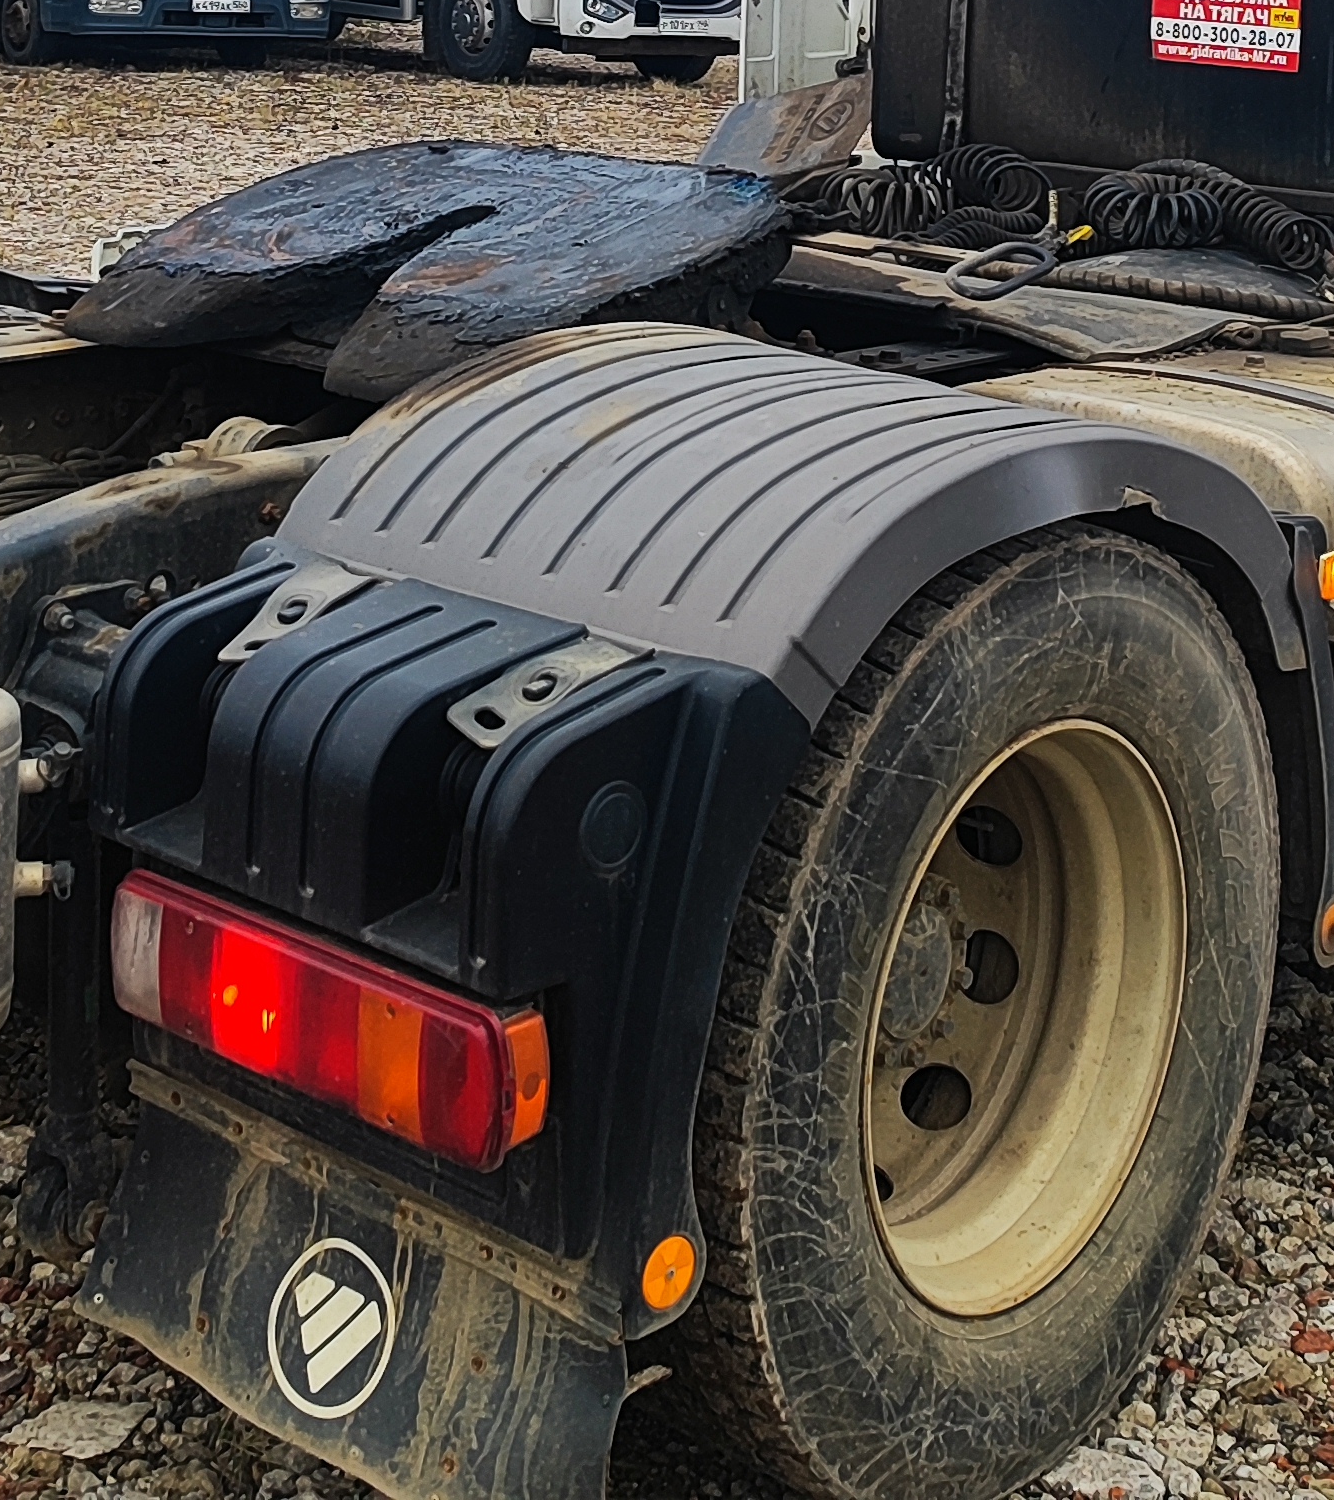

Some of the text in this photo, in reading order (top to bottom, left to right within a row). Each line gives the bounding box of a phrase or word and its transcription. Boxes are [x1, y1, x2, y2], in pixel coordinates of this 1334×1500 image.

[1179, 2, 1269, 25] НА ТЯГАЧ
[1155, 21, 1295, 49] 8-800-300-28-07
